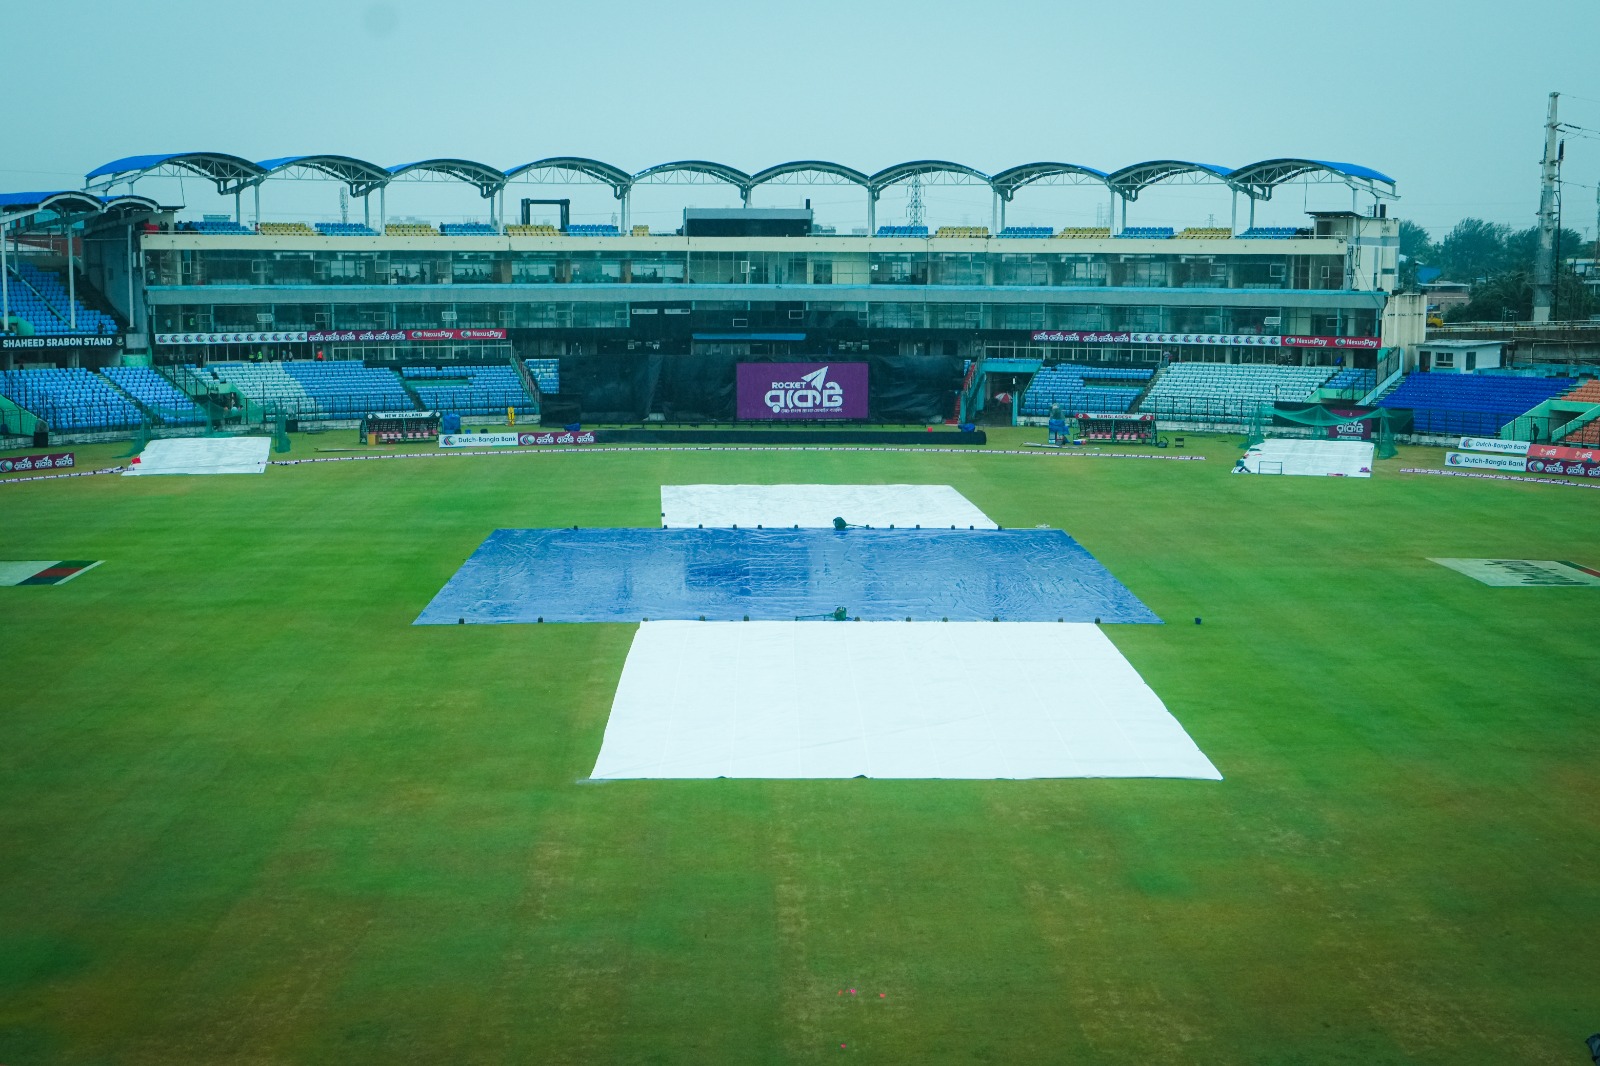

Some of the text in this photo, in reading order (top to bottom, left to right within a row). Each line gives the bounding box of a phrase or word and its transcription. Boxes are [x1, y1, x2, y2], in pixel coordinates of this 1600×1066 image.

[423, 330, 503, 339] NexusPay NexusPay
[3, 337, 113, 348] SHAHEED SRABON STAND
[1296, 338, 1378, 348] NexusPay NexusPay
[771, 381, 807, 389] ROCKET
[1475, 441, 1512, 449] Dutch-Bangla
[1464, 457, 1507, 466] Dutch-Bangla
